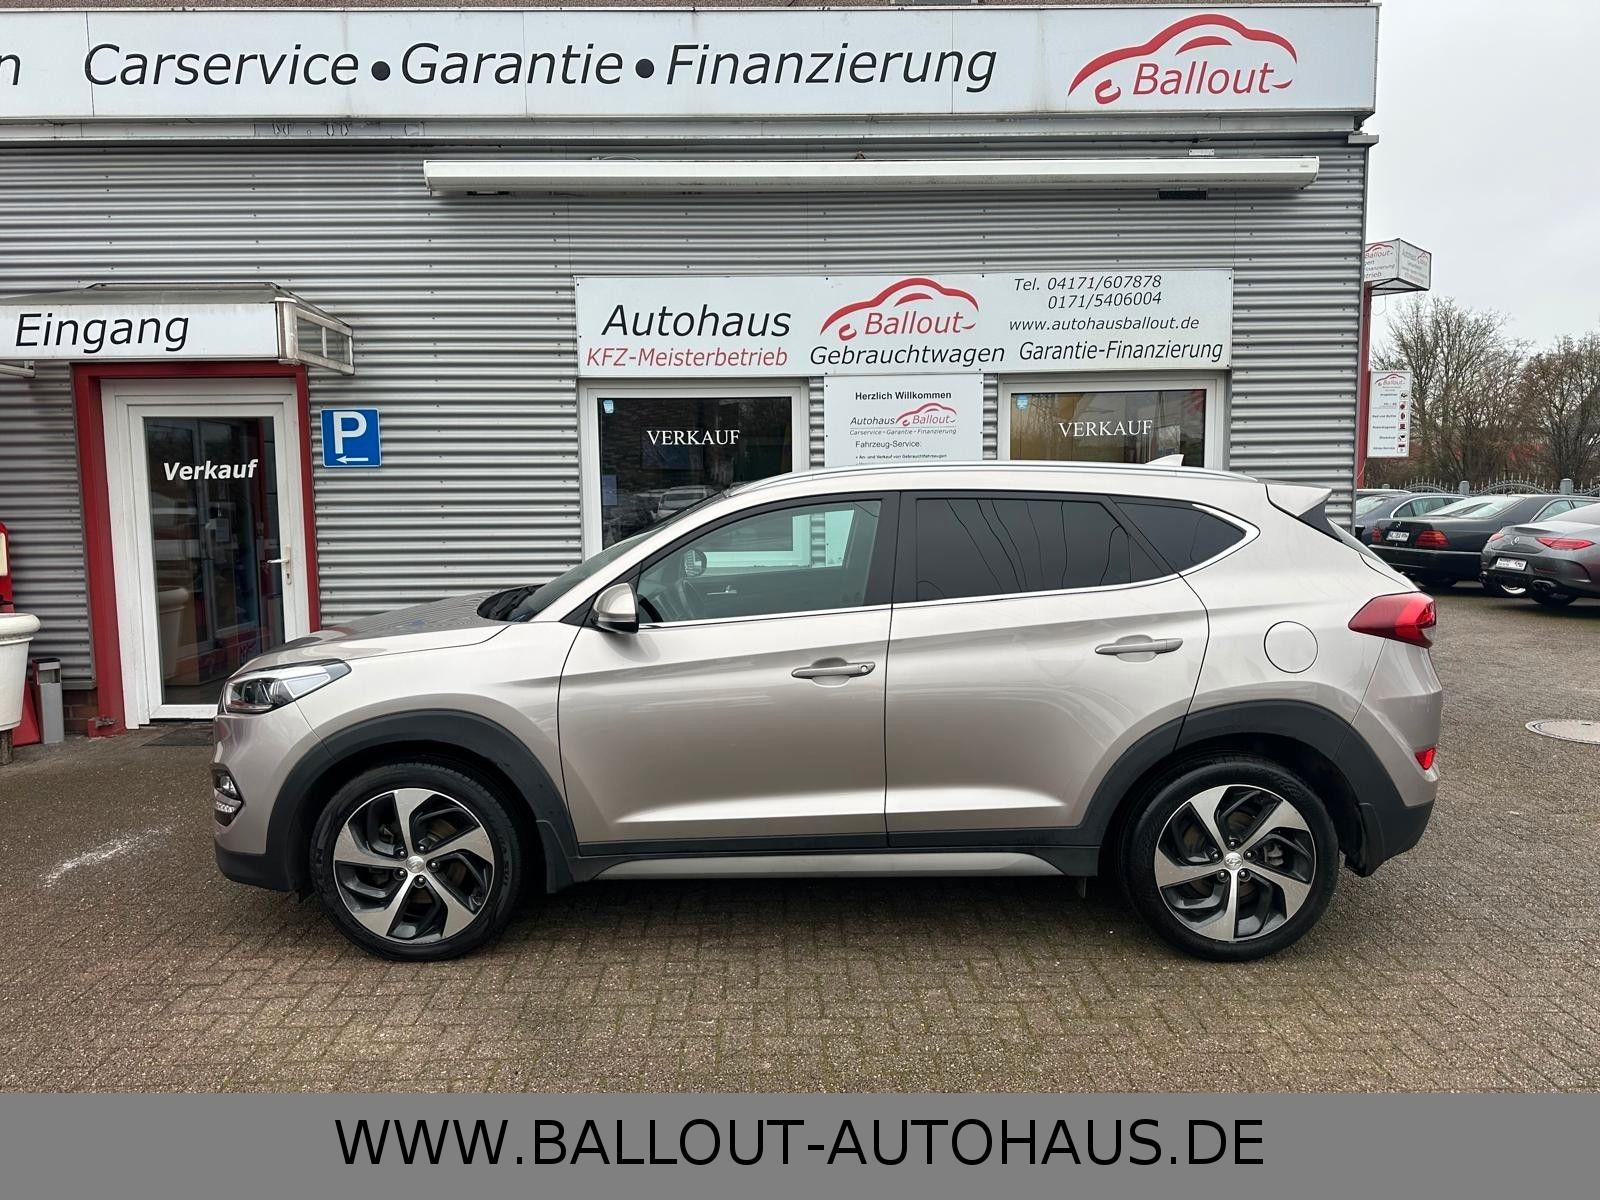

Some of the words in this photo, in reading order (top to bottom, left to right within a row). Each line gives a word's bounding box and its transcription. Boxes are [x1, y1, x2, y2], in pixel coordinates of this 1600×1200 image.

[84, 43, 359, 86] Carservice
[401, 42, 623, 85] Garantie
[666, 42, 997, 93] Finanzierung
[1132, 60, 1274, 95] Ballout
[1014, 277, 1041, 291] Tel.
[1047, 274, 1162, 291] 04171/607878
[1047, 291, 1162, 310] 0171/5406004
[601, 303, 792, 337] Autohaus
[864, 309, 964, 335] Ballout
[1009, 316, 1200, 331] www.autohausballout.de
[15, 312, 189, 354] Eingang
[586, 346, 788, 367] KFZ-Meisterbetrieb
[810, 344, 1005, 368] Gebrauchtwagen
[1019, 339, 1224, 363] Garantie-Finanzierung
[855, 392, 893, 400] Herzlich
[895, 391, 952, 400] Willkommen
[849, 416, 895, 426] Autohaus
[912, 414, 950, 425] Ballout
[1057, 419, 1153, 438] VERKAUF
[333, 411, 367, 454] P
[646, 429, 741, 446] VERKAUF
[886, 428, 913, 436] Garantie
[916, 427, 957, 436] Finanzierung
[163, 458, 259, 481] Verkauf
